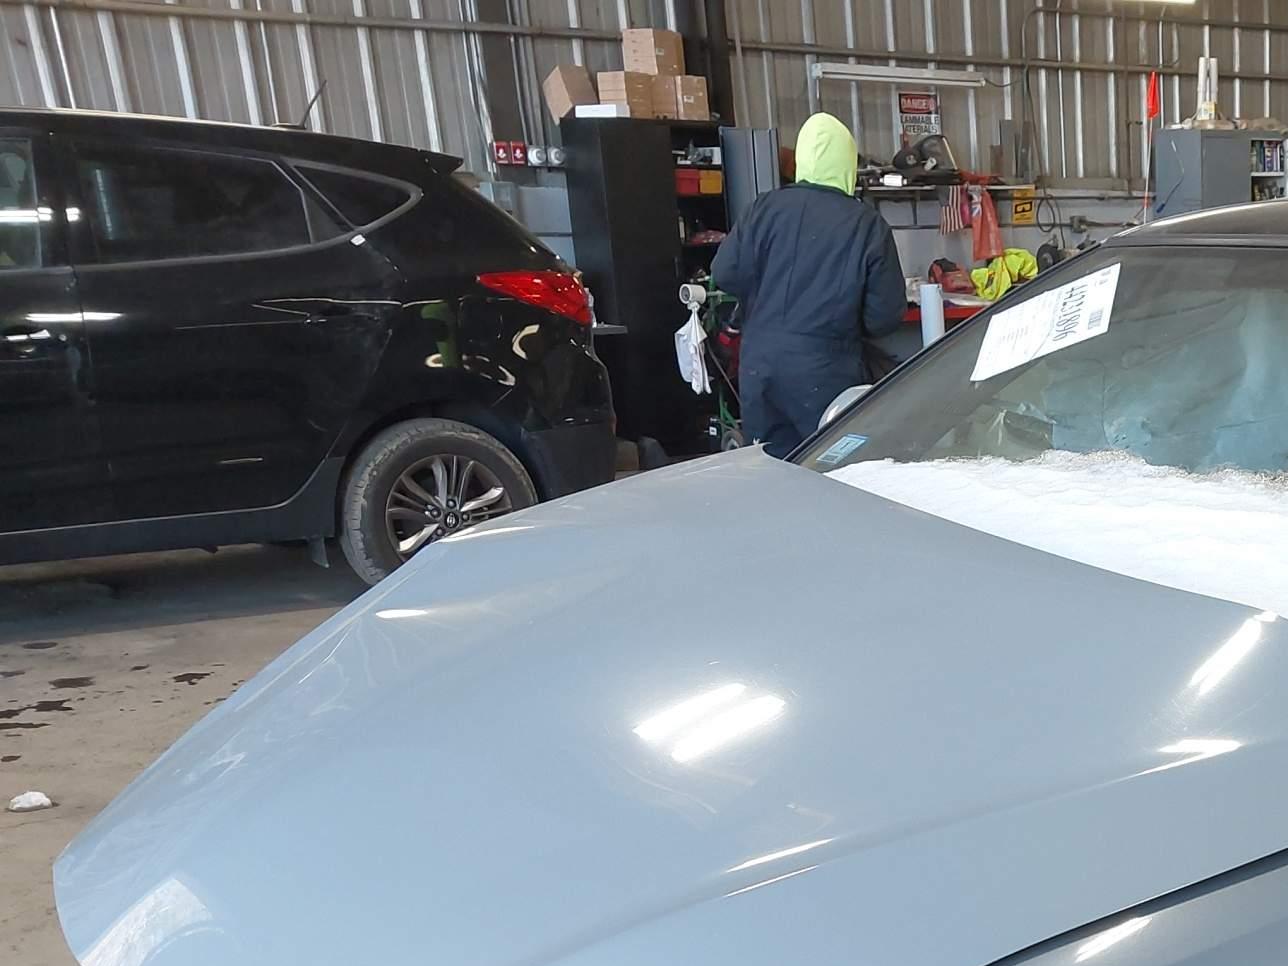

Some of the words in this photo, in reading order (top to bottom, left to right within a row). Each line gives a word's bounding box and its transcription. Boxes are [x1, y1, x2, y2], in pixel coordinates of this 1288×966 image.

[901, 98, 936, 111] DANGER
[900, 115, 939, 125] LAMMABLE
[904, 125, 938, 134] ATERIALS
